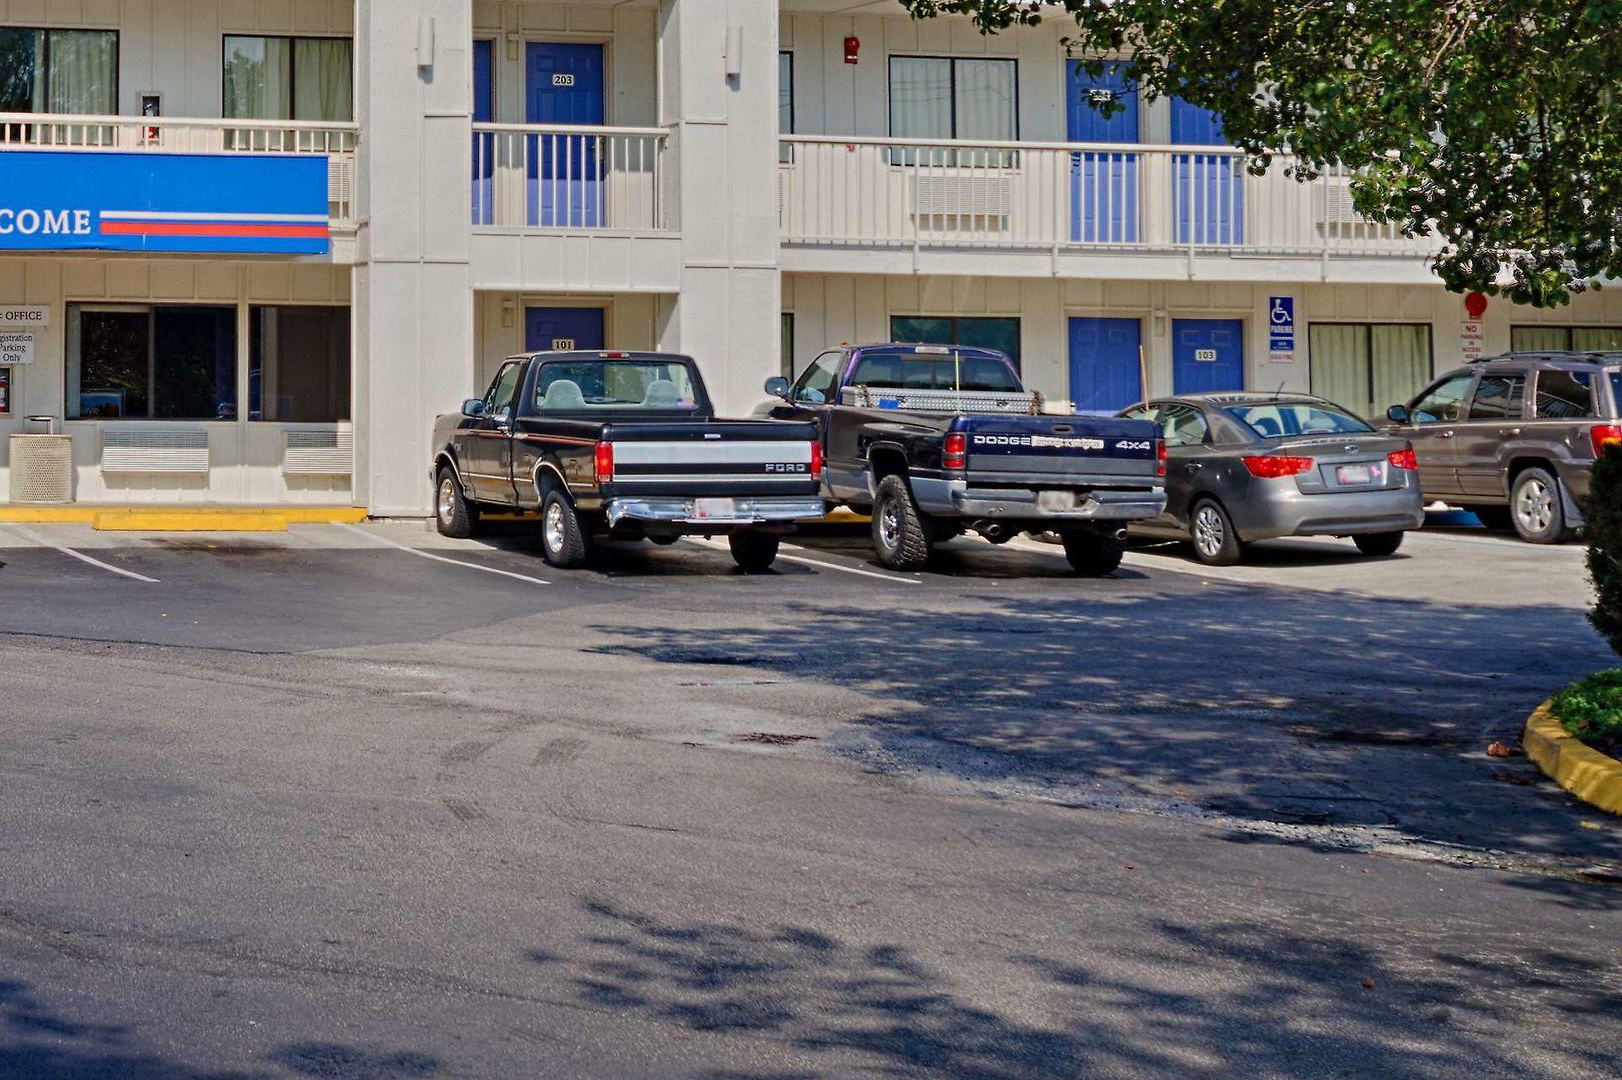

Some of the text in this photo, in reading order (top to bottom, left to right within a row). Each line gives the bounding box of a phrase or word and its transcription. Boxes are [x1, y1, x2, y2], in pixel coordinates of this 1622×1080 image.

[554, 75, 572, 85] 203
[5, 310, 43, 320] OFFICE
[556, 340, 571, 350] 101
[2, 353, 21, 363] Only
[1198, 351, 1214, 360] 103
[973, 435, 1031, 446] DODGE
[764, 463, 806, 472] FORD
